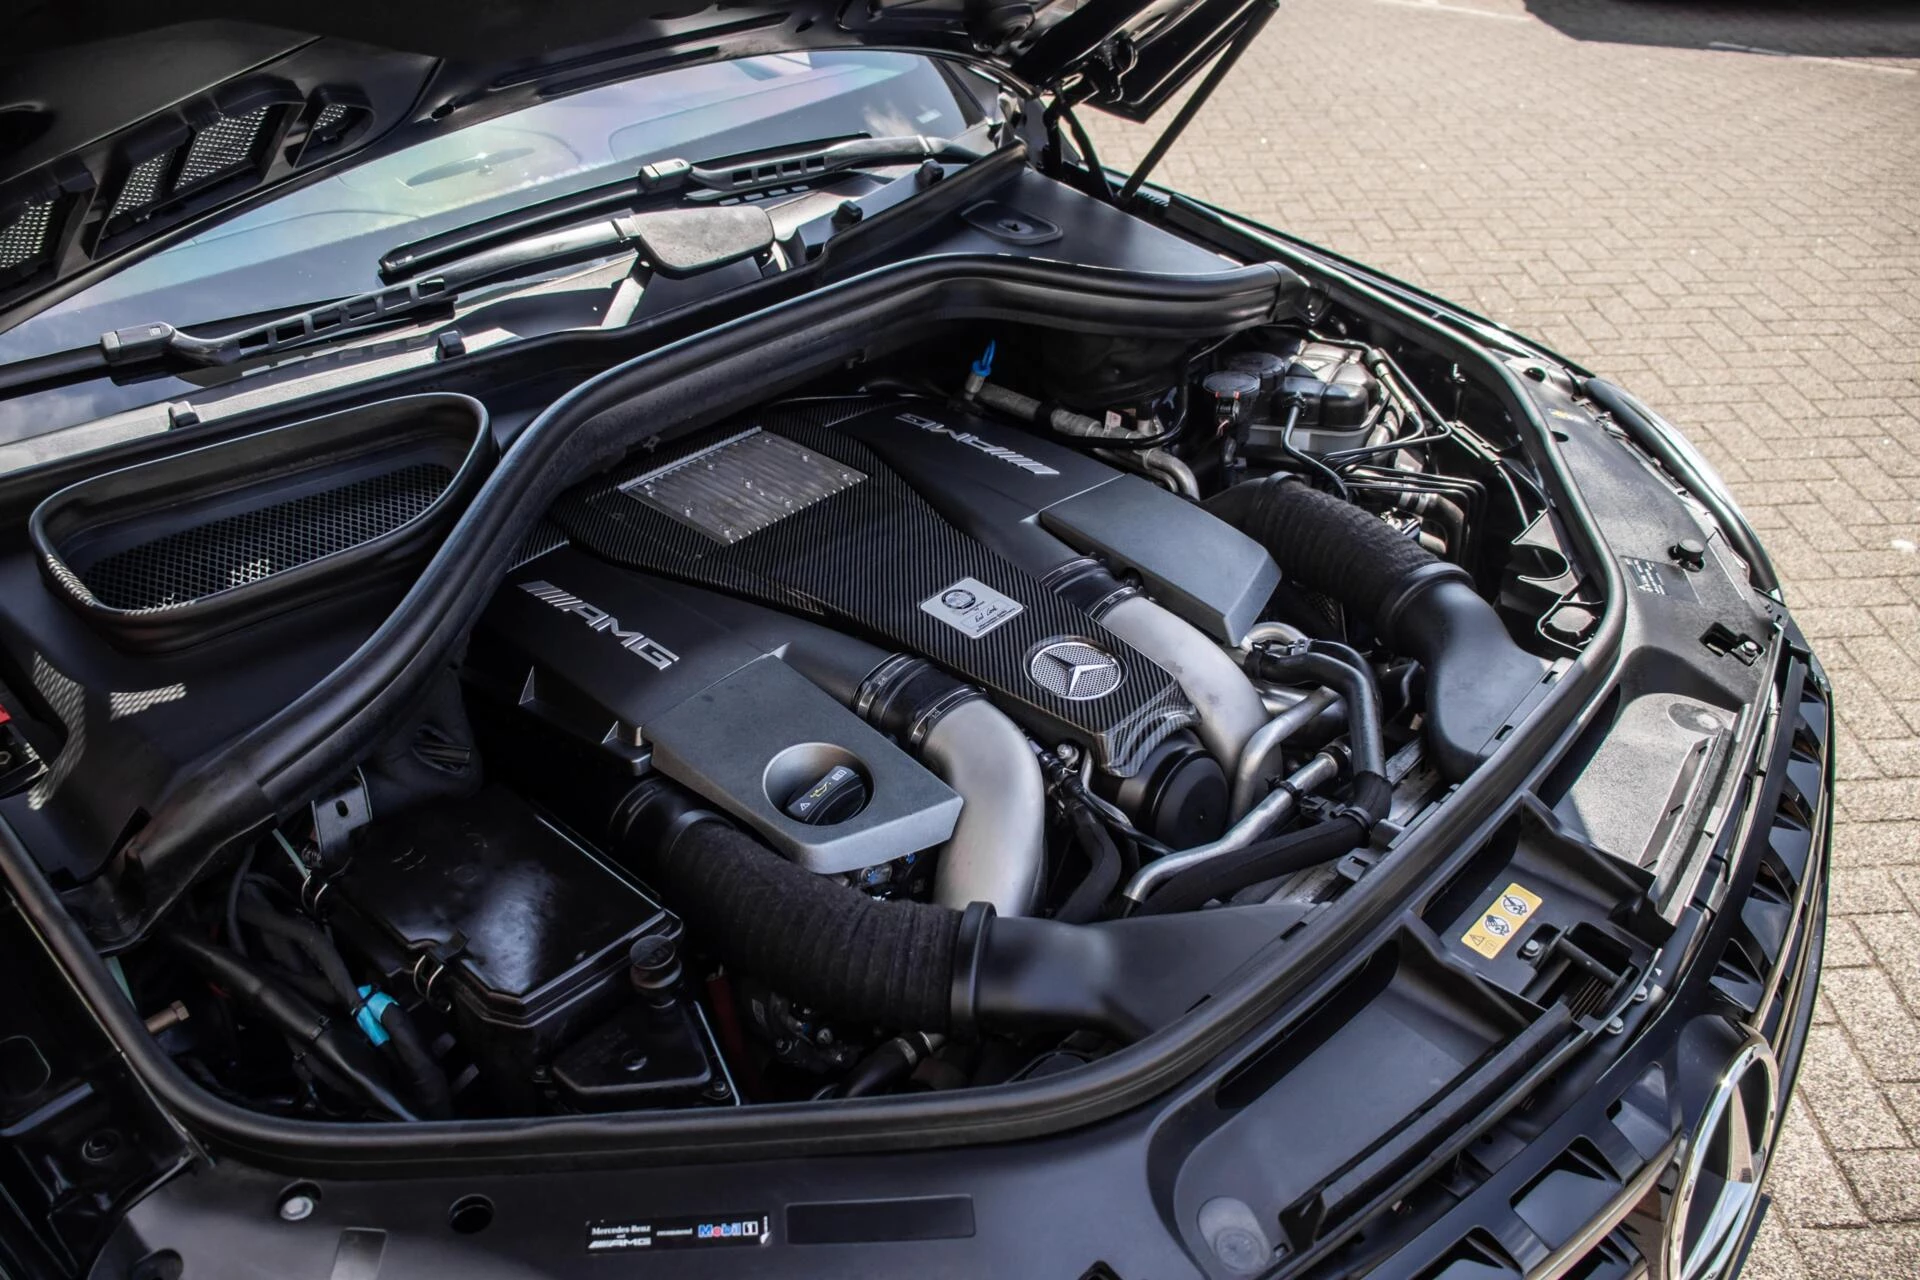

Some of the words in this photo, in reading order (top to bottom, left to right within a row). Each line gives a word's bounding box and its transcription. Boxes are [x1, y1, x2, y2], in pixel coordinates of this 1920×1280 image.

[896, 413, 1020, 458] AMG
[550, 597, 680, 671] AMG
[591, 1225, 651, 1235] Mercedes-Benz
[698, 1223, 741, 1238] Mobil
